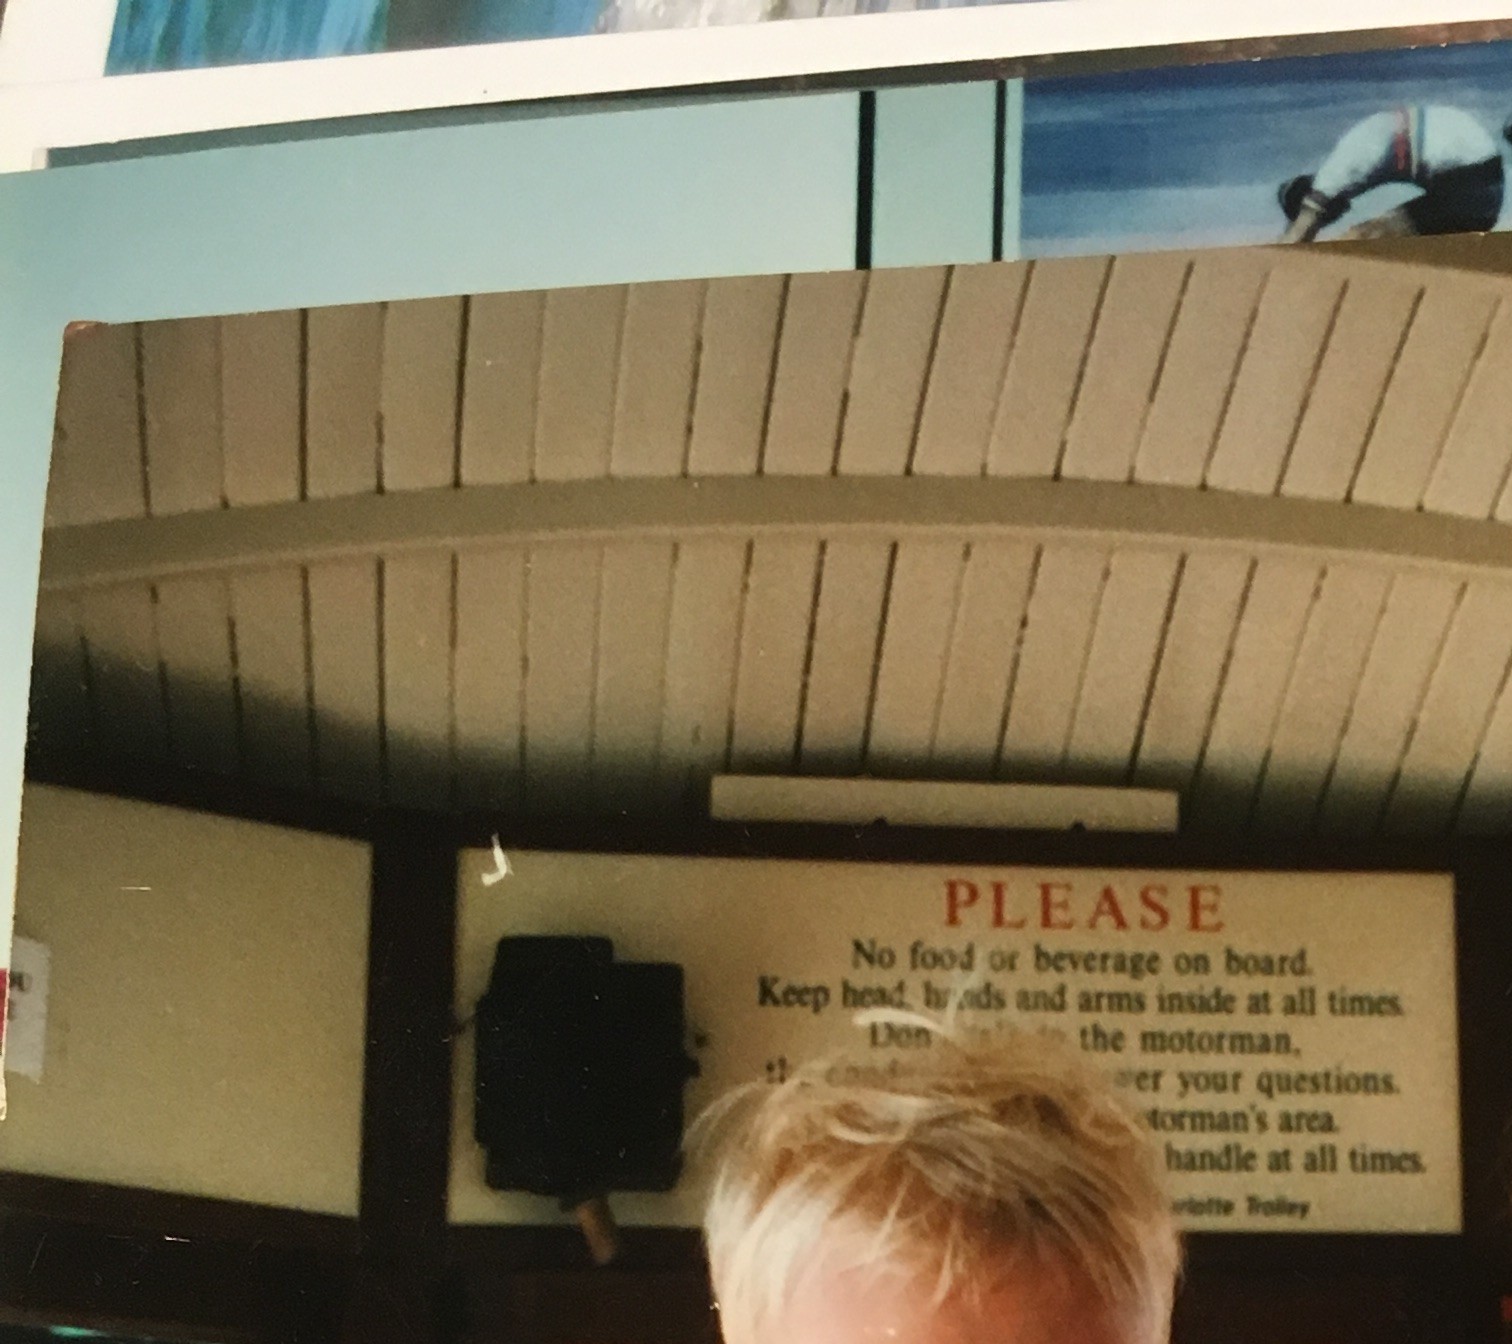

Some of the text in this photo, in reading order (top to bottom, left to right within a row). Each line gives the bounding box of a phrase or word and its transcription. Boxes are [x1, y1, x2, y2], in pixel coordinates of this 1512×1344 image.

[943, 878, 1225, 932] PLEASE
[852, 938, 1314, 980] No food or beverage on board.
[757, 975, 831, 1013] Keep
[1015, 983, 1068, 1012] and
[1078, 989, 1147, 1014] arms
[1156, 984, 1237, 1016] inside
[1247, 990, 1272, 1016] at
[1283, 986, 1316, 1016] all
[1079, 1024, 1125, 1053] the
[1175, 1070, 1243, 1100] your
[1255, 1062, 1400, 1100] questions.
[1165, 1141, 1427, 1175] handle at all times.
